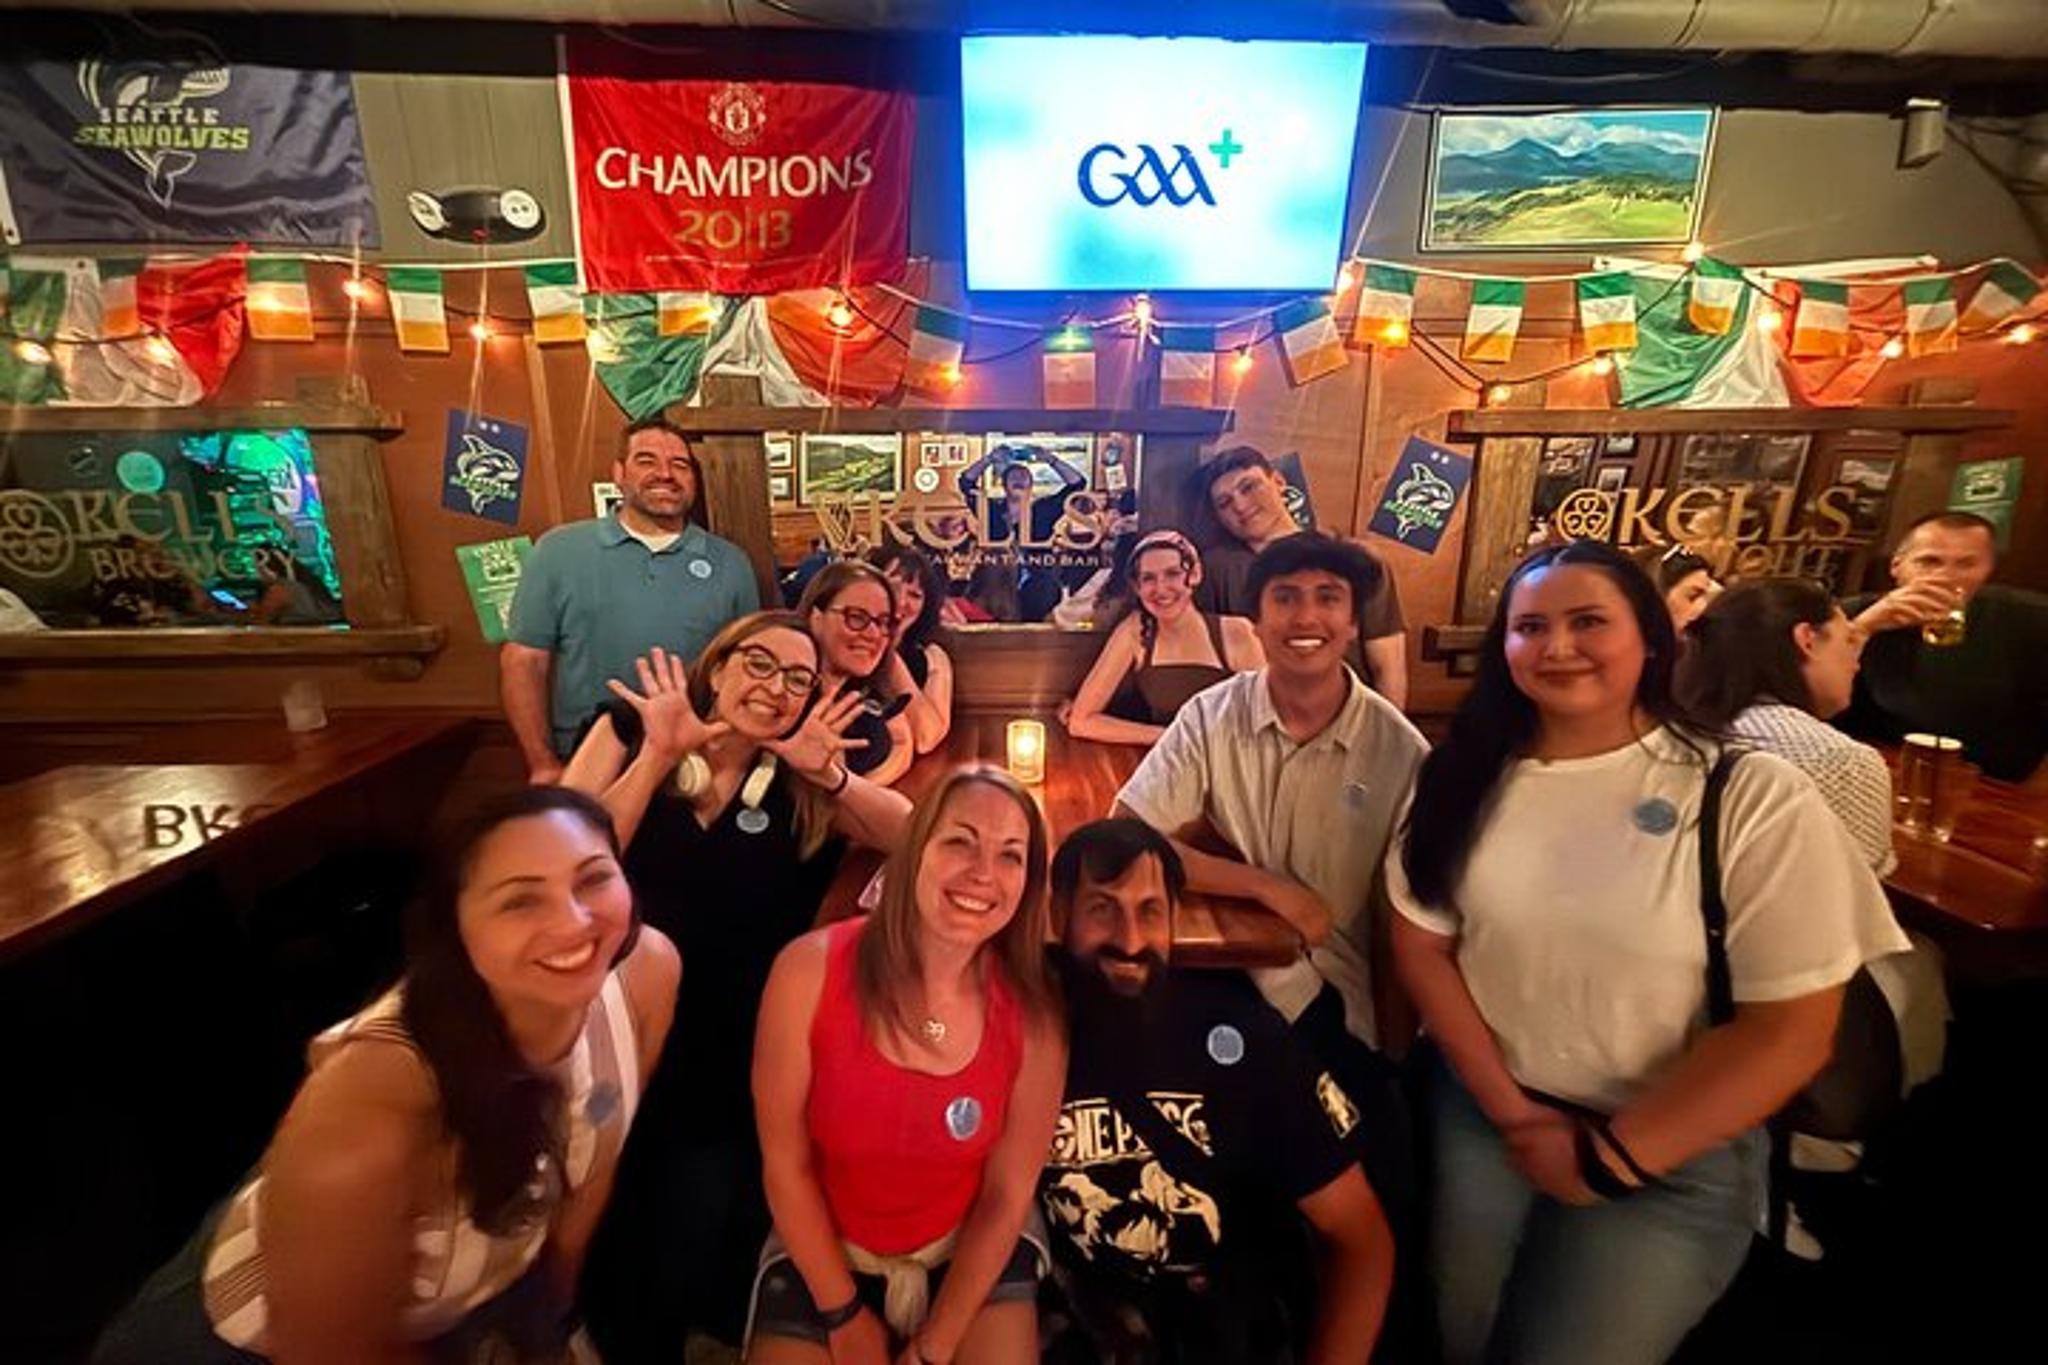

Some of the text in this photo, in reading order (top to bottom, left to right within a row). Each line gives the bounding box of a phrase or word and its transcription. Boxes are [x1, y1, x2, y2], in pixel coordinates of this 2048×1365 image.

[74, 125, 249, 149] SEAWOLVES
[101, 107, 219, 123] SEATTLE
[595, 147, 873, 197] CHAMPIONS
[862, 489, 1102, 548] KELLS
[1618, 486, 1856, 545] KELLS
